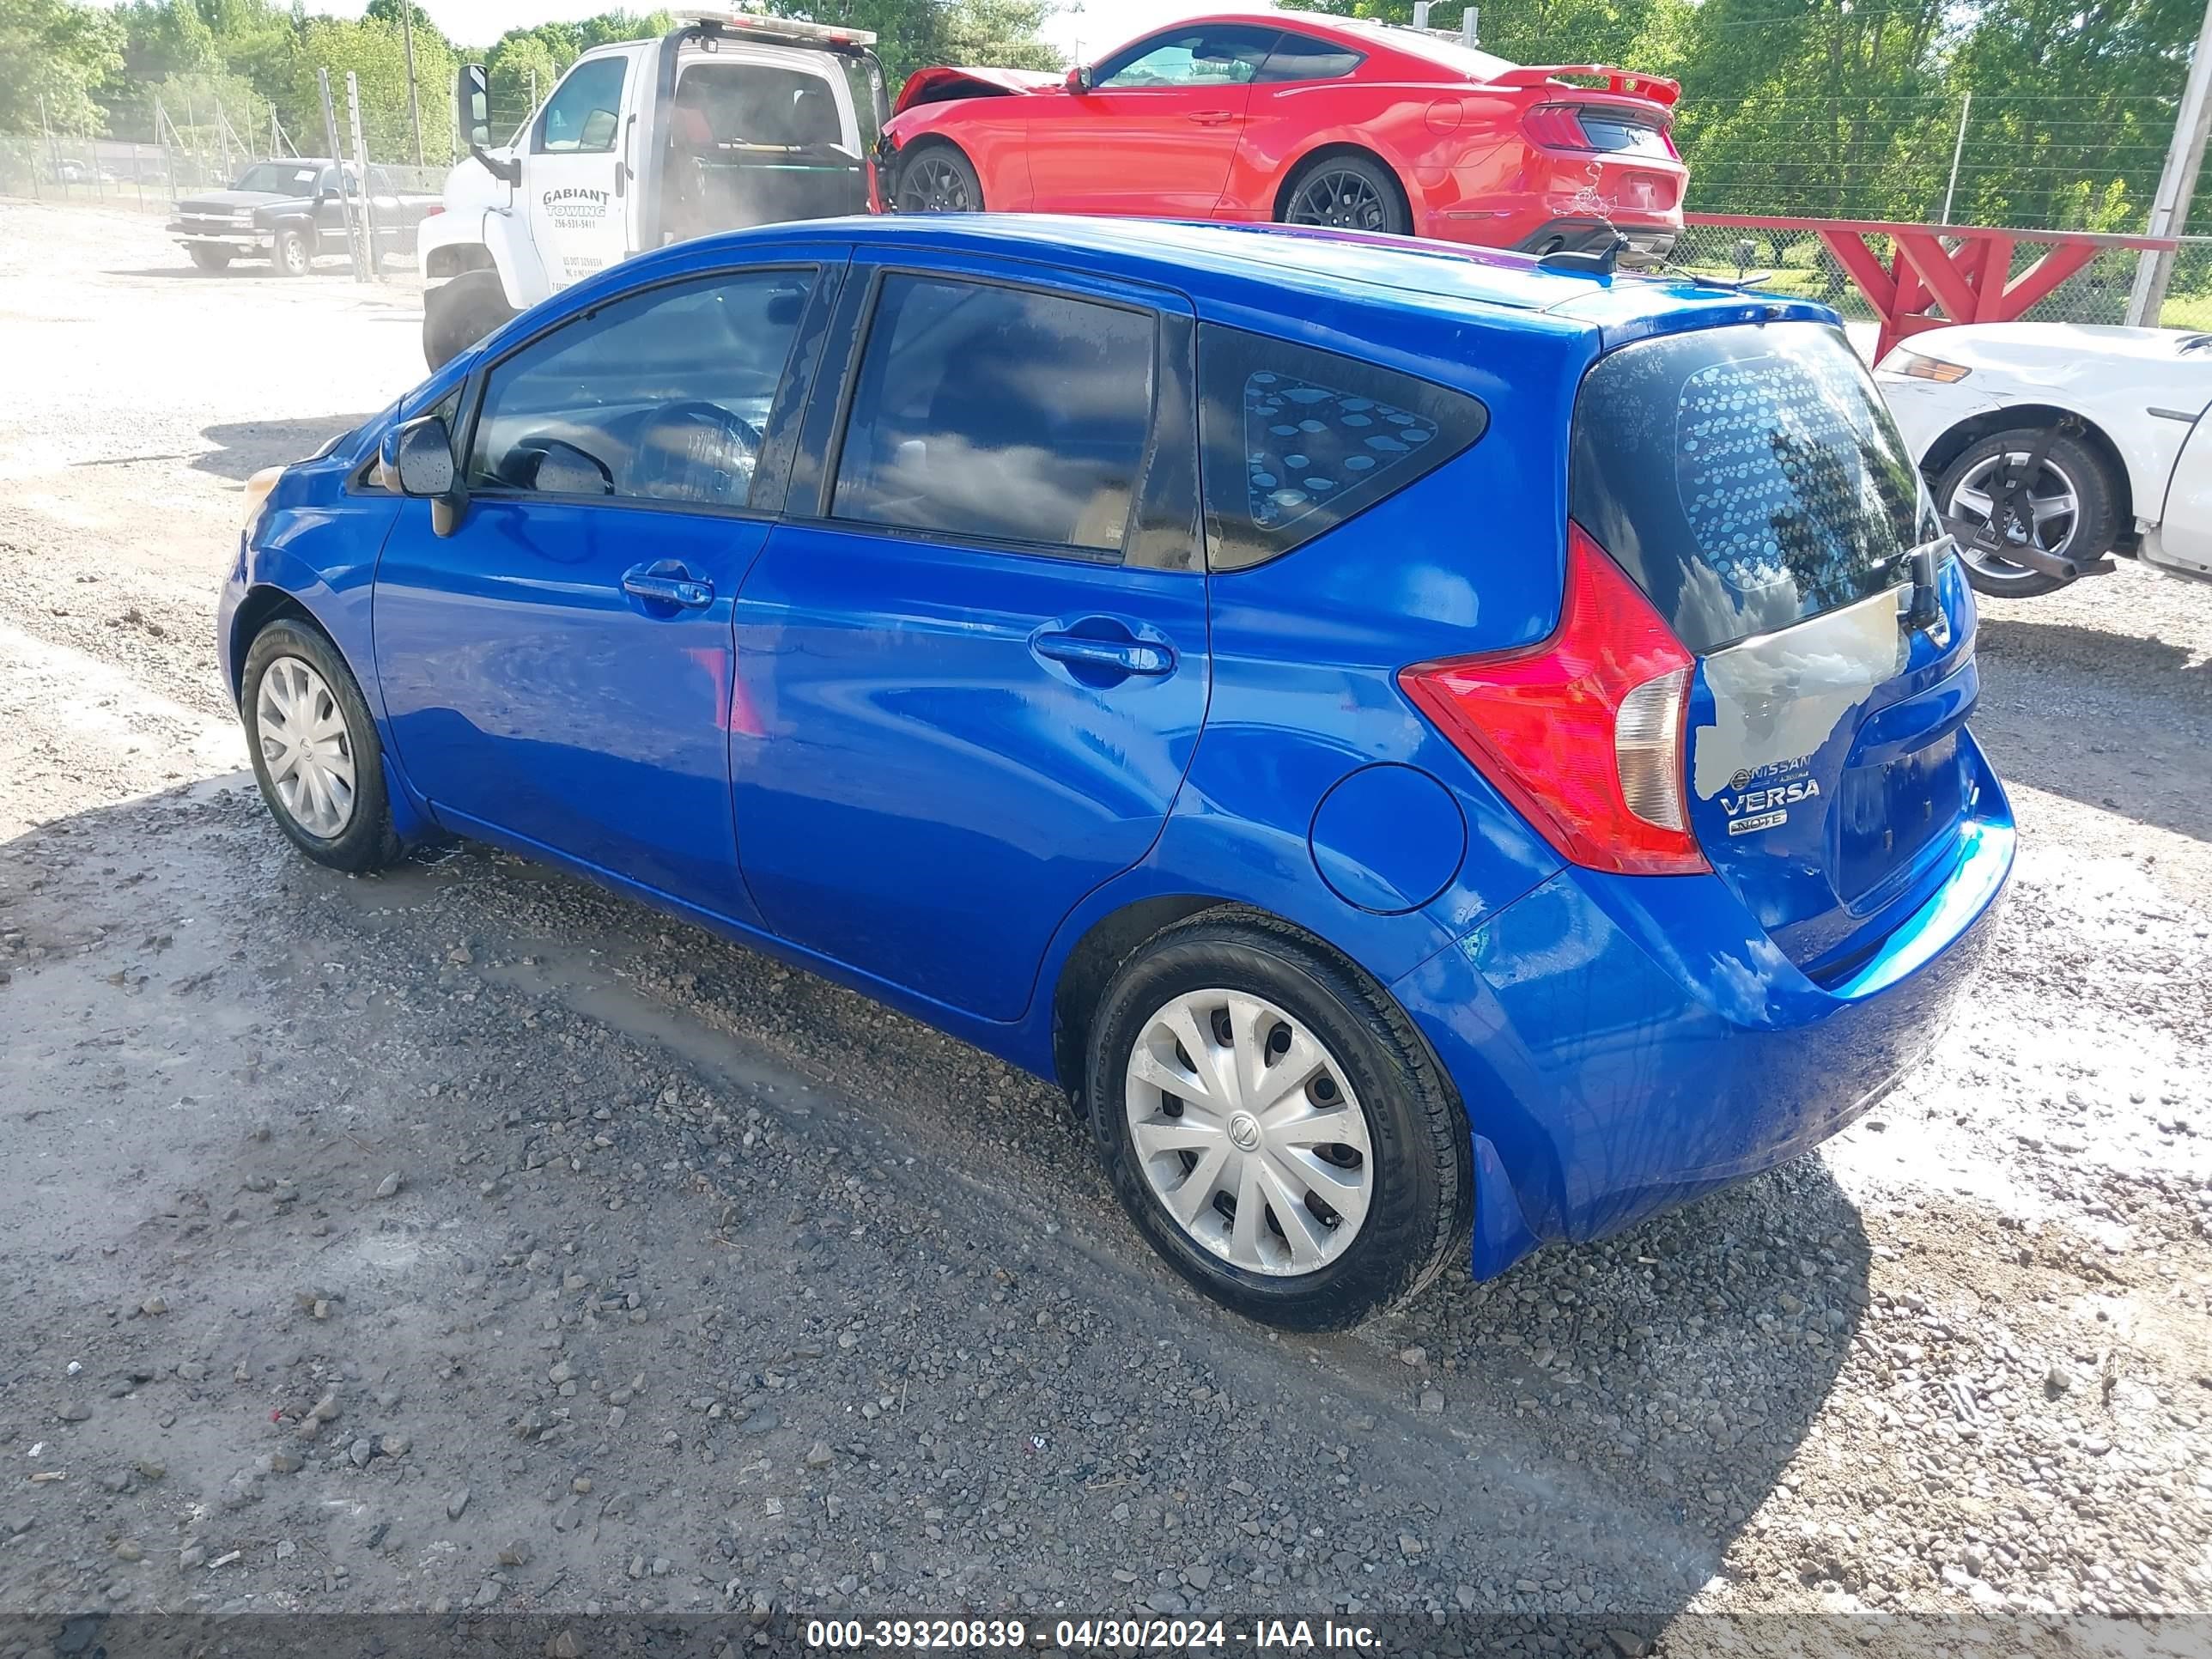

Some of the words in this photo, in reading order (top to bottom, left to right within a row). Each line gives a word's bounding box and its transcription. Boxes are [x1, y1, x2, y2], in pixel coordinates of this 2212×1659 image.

[543, 188, 611, 205] GABIANT
[545, 204, 606, 217] TOWING
[1749, 755, 1812, 780] NISSAN
[1720, 779, 1820, 816] VERSA
[1734, 812, 1784, 833] NOTE
